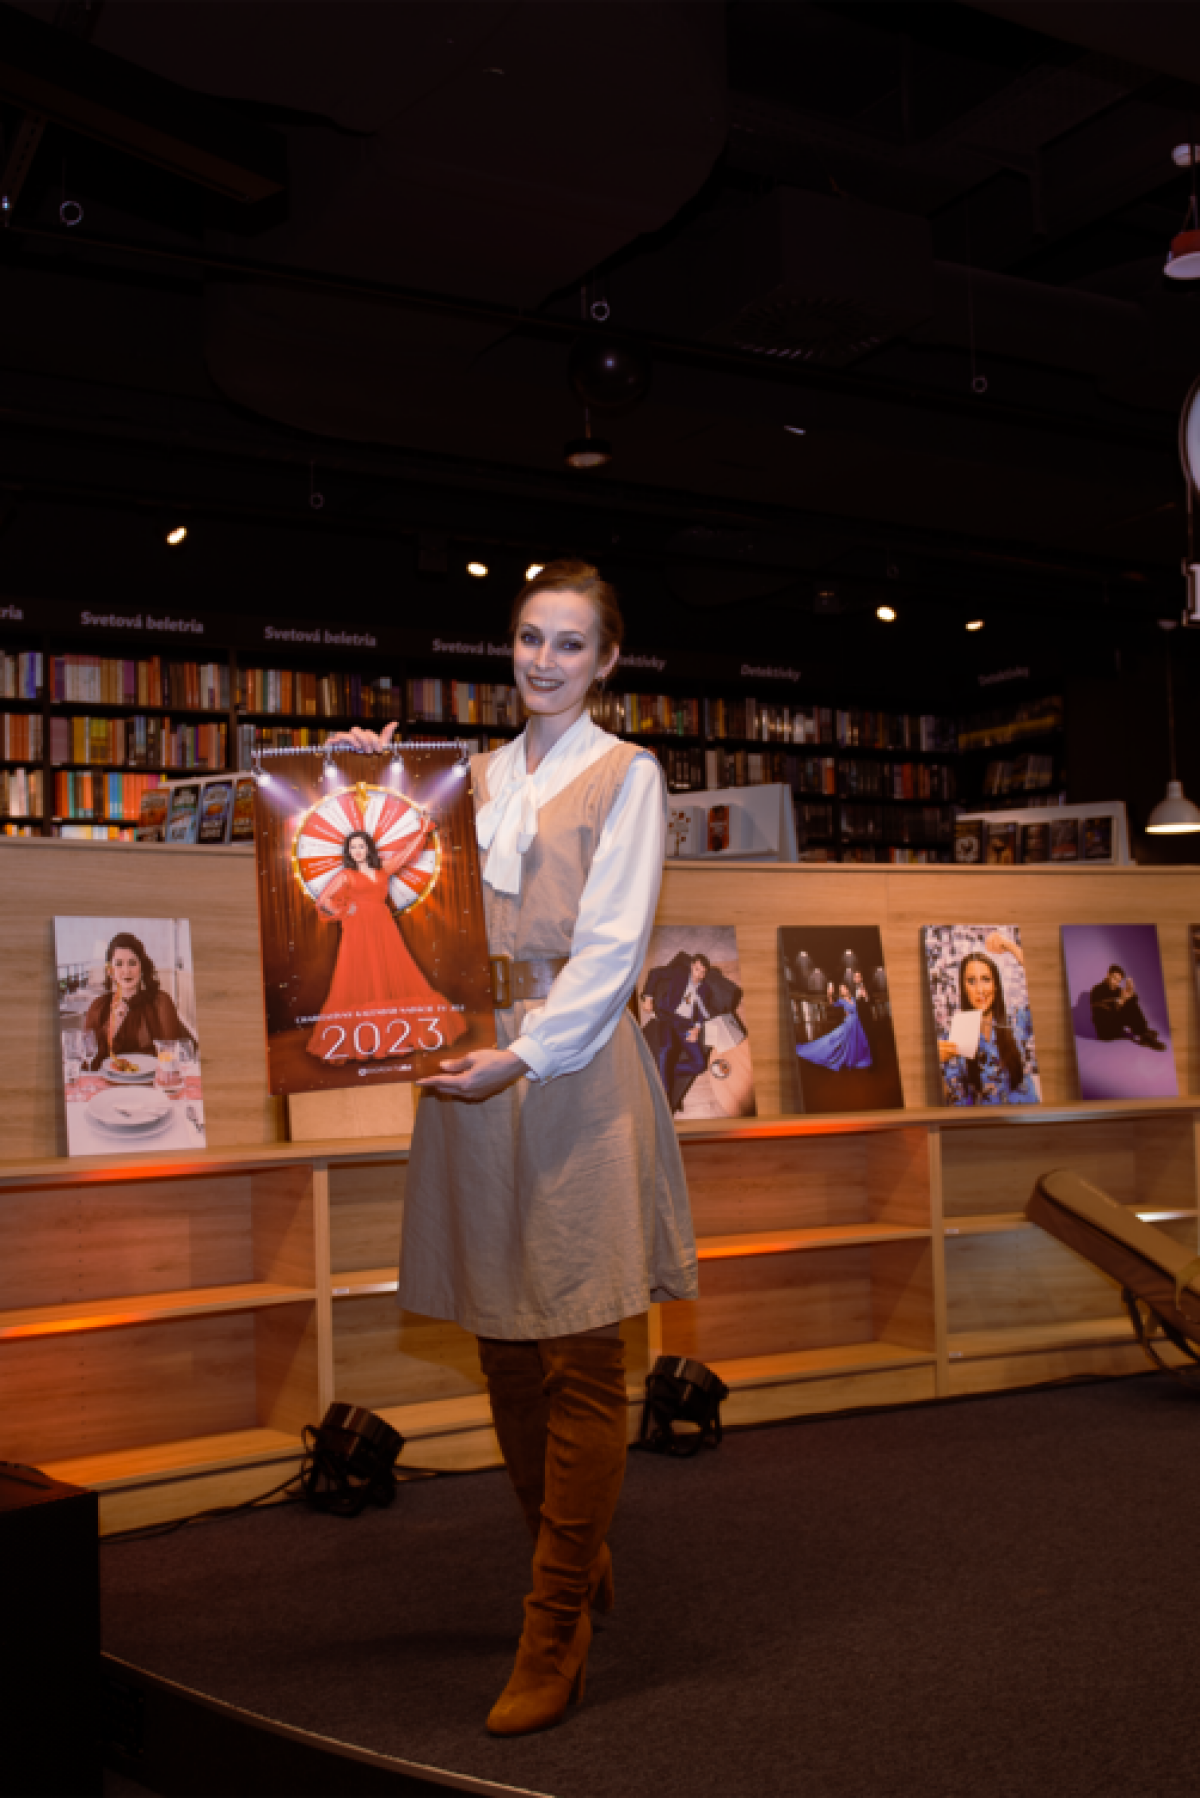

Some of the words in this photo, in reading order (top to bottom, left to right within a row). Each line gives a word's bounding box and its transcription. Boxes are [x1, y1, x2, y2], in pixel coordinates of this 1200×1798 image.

[0, 604, 24, 620] ria
[80, 610, 142, 630] Svetová
[145, 614, 204, 635] beletria
[264, 625, 321, 644] Svetová
[323, 629, 377, 648] beletria
[432, 638, 484, 656] Svetová
[487, 641, 513, 658] bele
[322, 1016, 444, 1060] 2023
